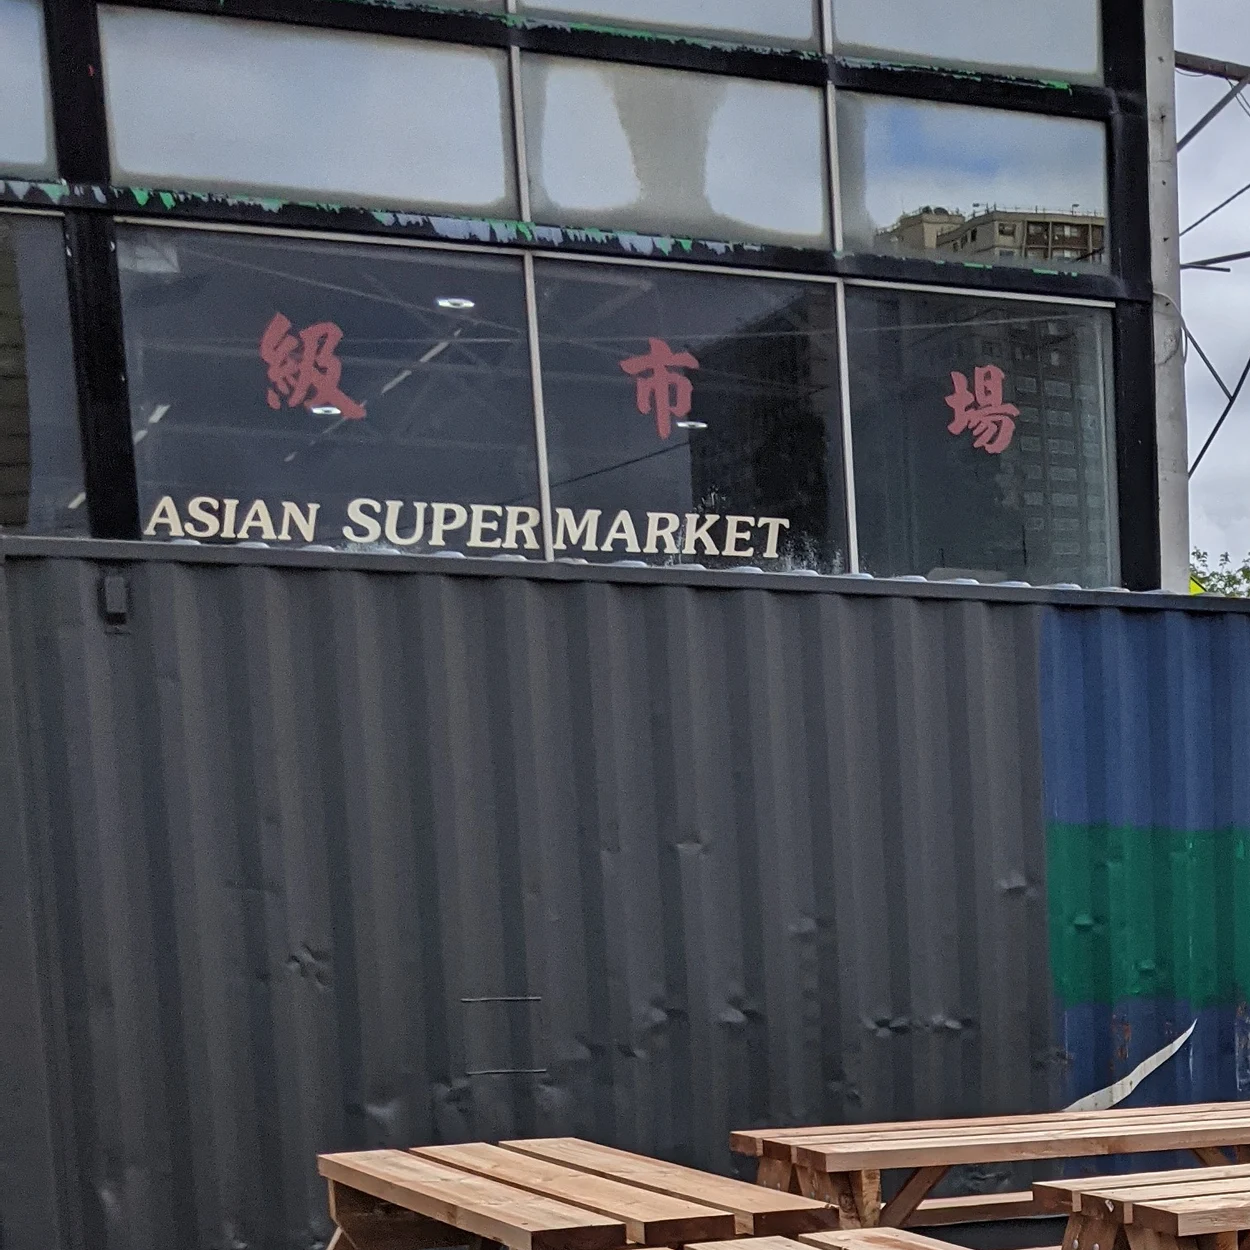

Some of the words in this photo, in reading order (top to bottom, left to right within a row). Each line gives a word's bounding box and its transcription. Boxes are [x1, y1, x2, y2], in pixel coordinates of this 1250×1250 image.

[620, 338, 699, 439] 市
[945, 366, 1020, 455] 場
[143, 496, 321, 542] ASIAN
[342, 498, 790, 558] SUPERMARKET
